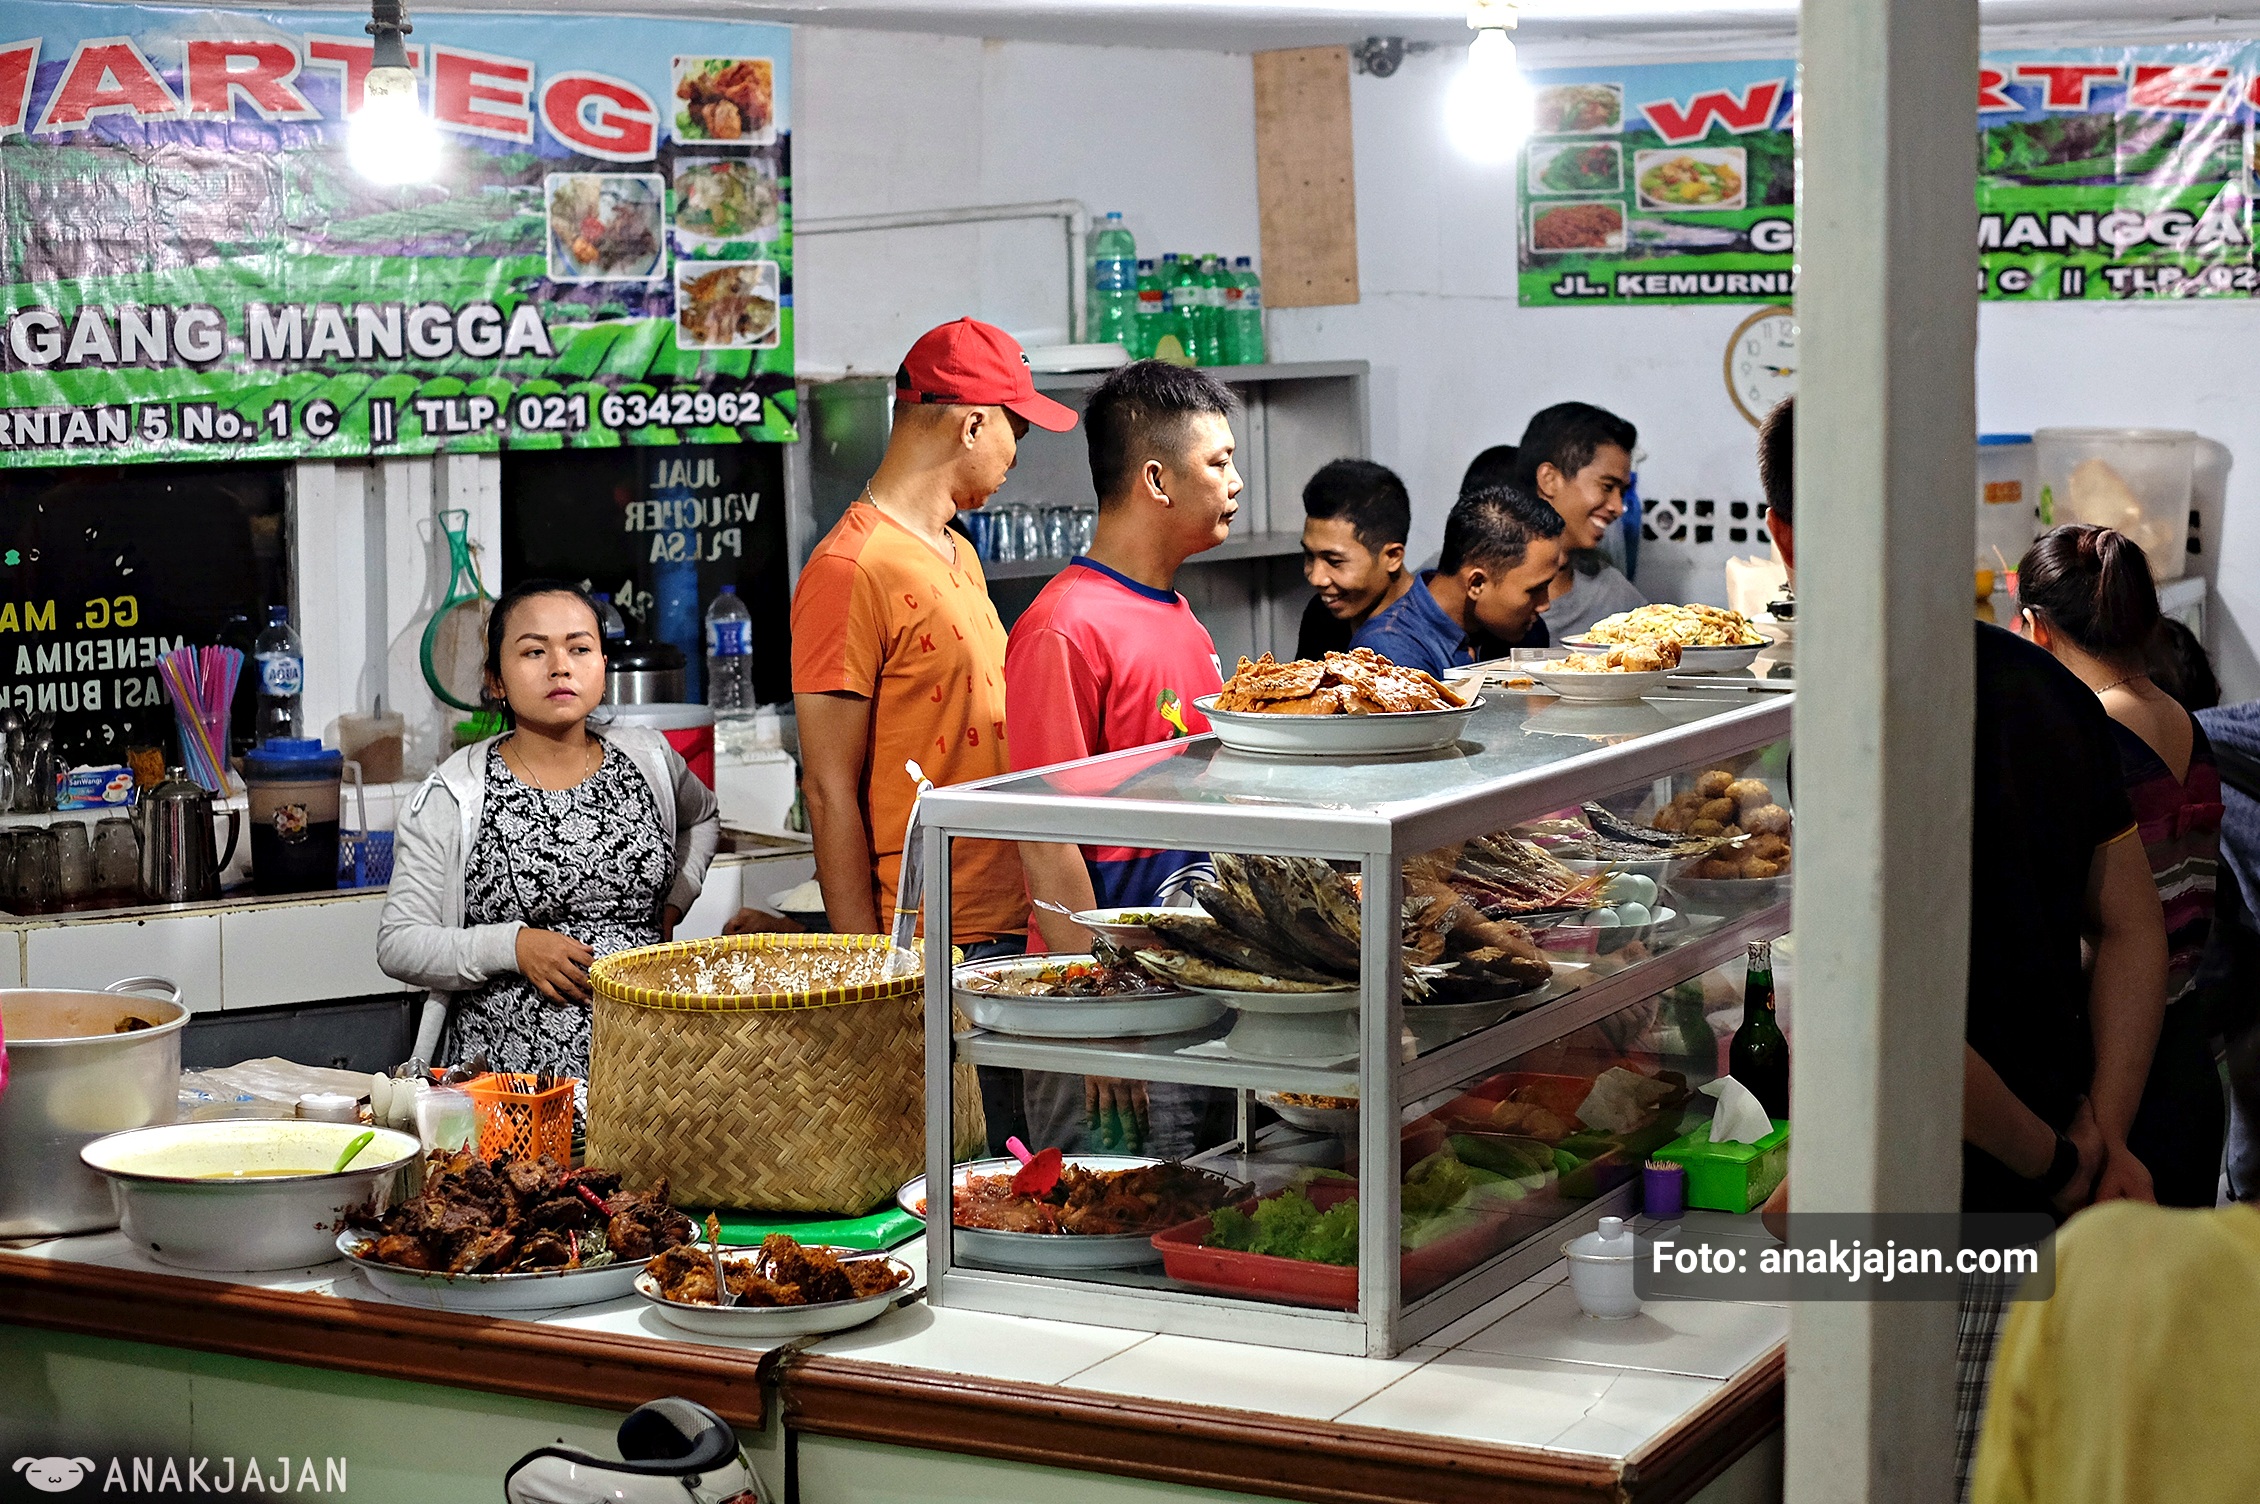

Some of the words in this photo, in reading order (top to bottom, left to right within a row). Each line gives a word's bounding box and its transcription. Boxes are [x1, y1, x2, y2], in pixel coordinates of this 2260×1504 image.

[0, 32, 660, 162] ARTEG
[1554, 274, 1606, 296] JL.
[1617, 274, 1797, 296] KEMURNI
[1999, 268, 2029, 292] C
[10, 307, 222, 366] GANG
[250, 304, 554, 361] MANGGA
[143, 408, 168, 440] 5
[183, 406, 253, 440] No.
[268, 403, 287, 437] 1
[306, 403, 336, 436] C
[417, 397, 506, 433] TLP.
[519, 396, 588, 428] 021
[602, 391, 761, 428] 6342962
[269, 667, 299, 681] AQUA
